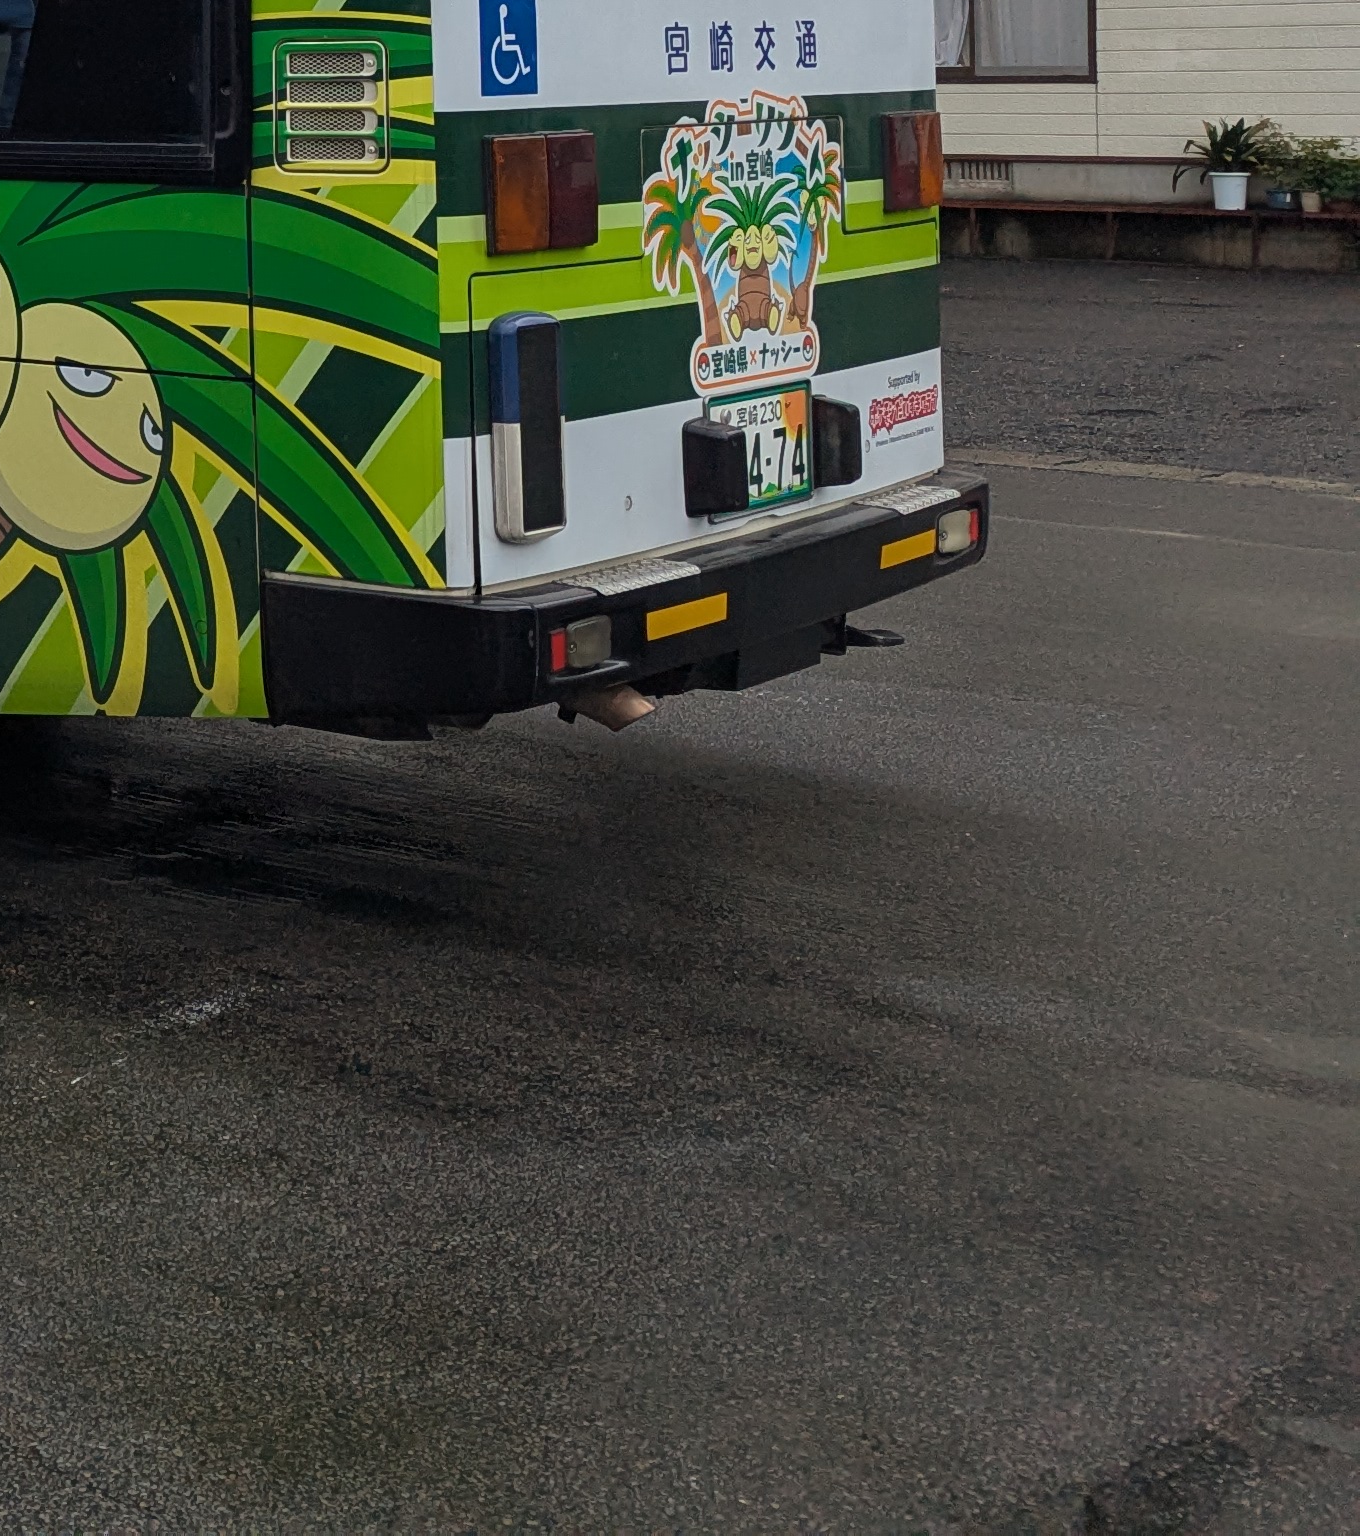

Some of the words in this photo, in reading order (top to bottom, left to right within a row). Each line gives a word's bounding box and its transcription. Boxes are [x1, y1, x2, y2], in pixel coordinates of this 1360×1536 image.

[664, 19, 818, 75] 宮崎交通
[887, 372, 914, 390] Supported
[749, 423, 806, 498] 4-74
